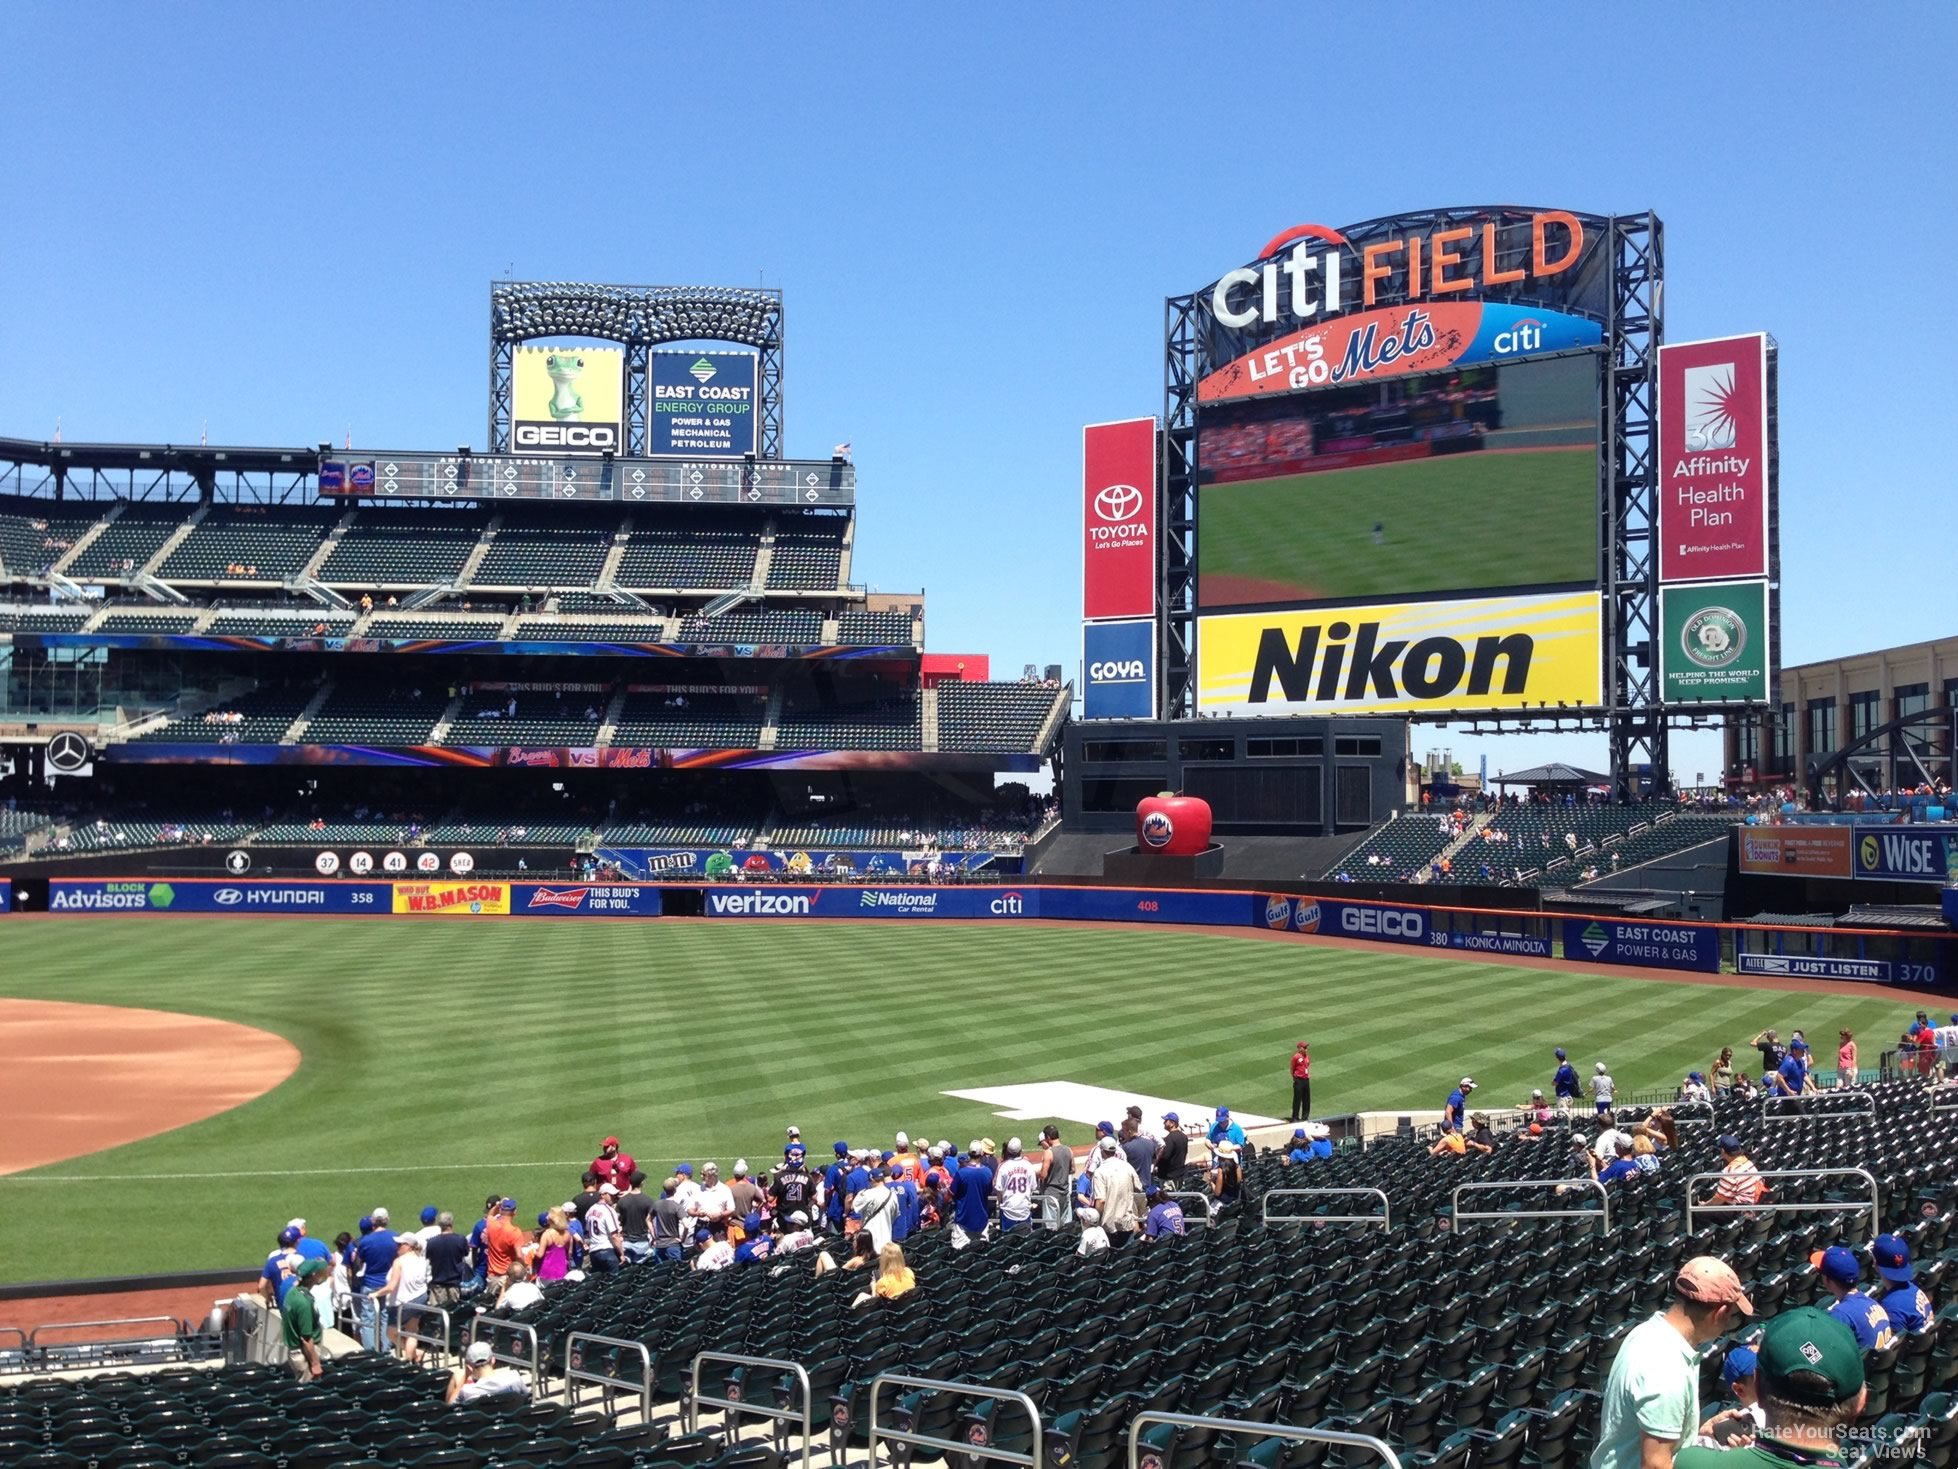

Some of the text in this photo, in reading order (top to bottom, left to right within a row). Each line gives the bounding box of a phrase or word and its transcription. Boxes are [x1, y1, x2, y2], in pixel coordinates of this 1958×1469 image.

[1213, 210, 1583, 329] citi FIELD
[1330, 309, 1436, 384] Mets
[1494, 325, 1541, 355] citi
[1247, 335, 1324, 382] LET'S
[1289, 367, 1329, 389] GO
[655, 385, 750, 400] EAST COAST
[655, 403, 750, 414] ENERGY GROUP
[671, 417, 731, 427] POWER & GAS
[516, 425, 614, 447] GEICO
[671, 429, 731, 438] MECHANICAL
[671, 439, 731, 449] PETROLEUM
[509, 458, 554, 466] LEAGUE
[682, 462, 740, 470] NATIONAL
[1673, 455, 1750, 478] Affinity
[1678, 482, 1745, 505] Health
[1690, 507, 1733, 528] Plan
[1089, 523, 1148, 540] TOYOTA
[1095, 538, 1143, 549] Let's Go Places
[1686, 541, 1745, 553] Affinity Health Plan
[1690, 619, 1704, 632] OLD
[325, 640, 343, 650] VS
[735, 646, 752, 655] VS
[1247, 621, 1534, 704] Nikon
[1089, 660, 1144, 680] GOYA
[1668, 672, 1706, 680] HELPING
[1728, 669, 1760, 677] WORLD
[563, 683, 581, 692] FOR
[666, 685, 688, 693] THIS
[719, 686, 738, 694] FOR
[570, 753, 596, 764] VS
[609, 748, 650, 768] Mets
[1754, 850, 1779, 861] DONUTS
[1883, 834, 1934, 873] WISE
[321, 858, 335, 868] 37
[355, 858, 367, 868] 14
[389, 858, 401, 868] 41
[420, 858, 436, 868] 42
[453, 859, 471, 868] SHEA
[107, 883, 145, 892] BLOCK
[415, 886, 430, 894] BUT
[590, 888, 640, 897] THIS BUD'S
[52, 890, 145, 908] Advisors
[247, 890, 324, 904] HYUNDAI
[351, 893, 374, 904] 358
[533, 892, 583, 903] Budweiser
[712, 891, 809, 914] verizon
[877, 893, 936, 906] National
[589, 899, 630, 909] FOR YOU.
[991, 898, 1022, 914] citi
[1137, 901, 1158, 912] 408
[1266, 905, 1289, 921] Gulf
[1296, 906, 1320, 924] Gulf
[1342, 907, 1423, 938] GEICO
[1430, 932, 1448, 945] 380
[1616, 926, 1696, 943] EAST COAST
[1465, 936, 1546, 953] KONICA MINOLTA
[1616, 944, 1697, 961] POWER & GAS
[1793, 961, 1826, 972] JUST
[1901, 964, 1935, 982] 370
[1007, 1176, 1027, 1194] 48
[786, 1183, 802, 1201] 21
